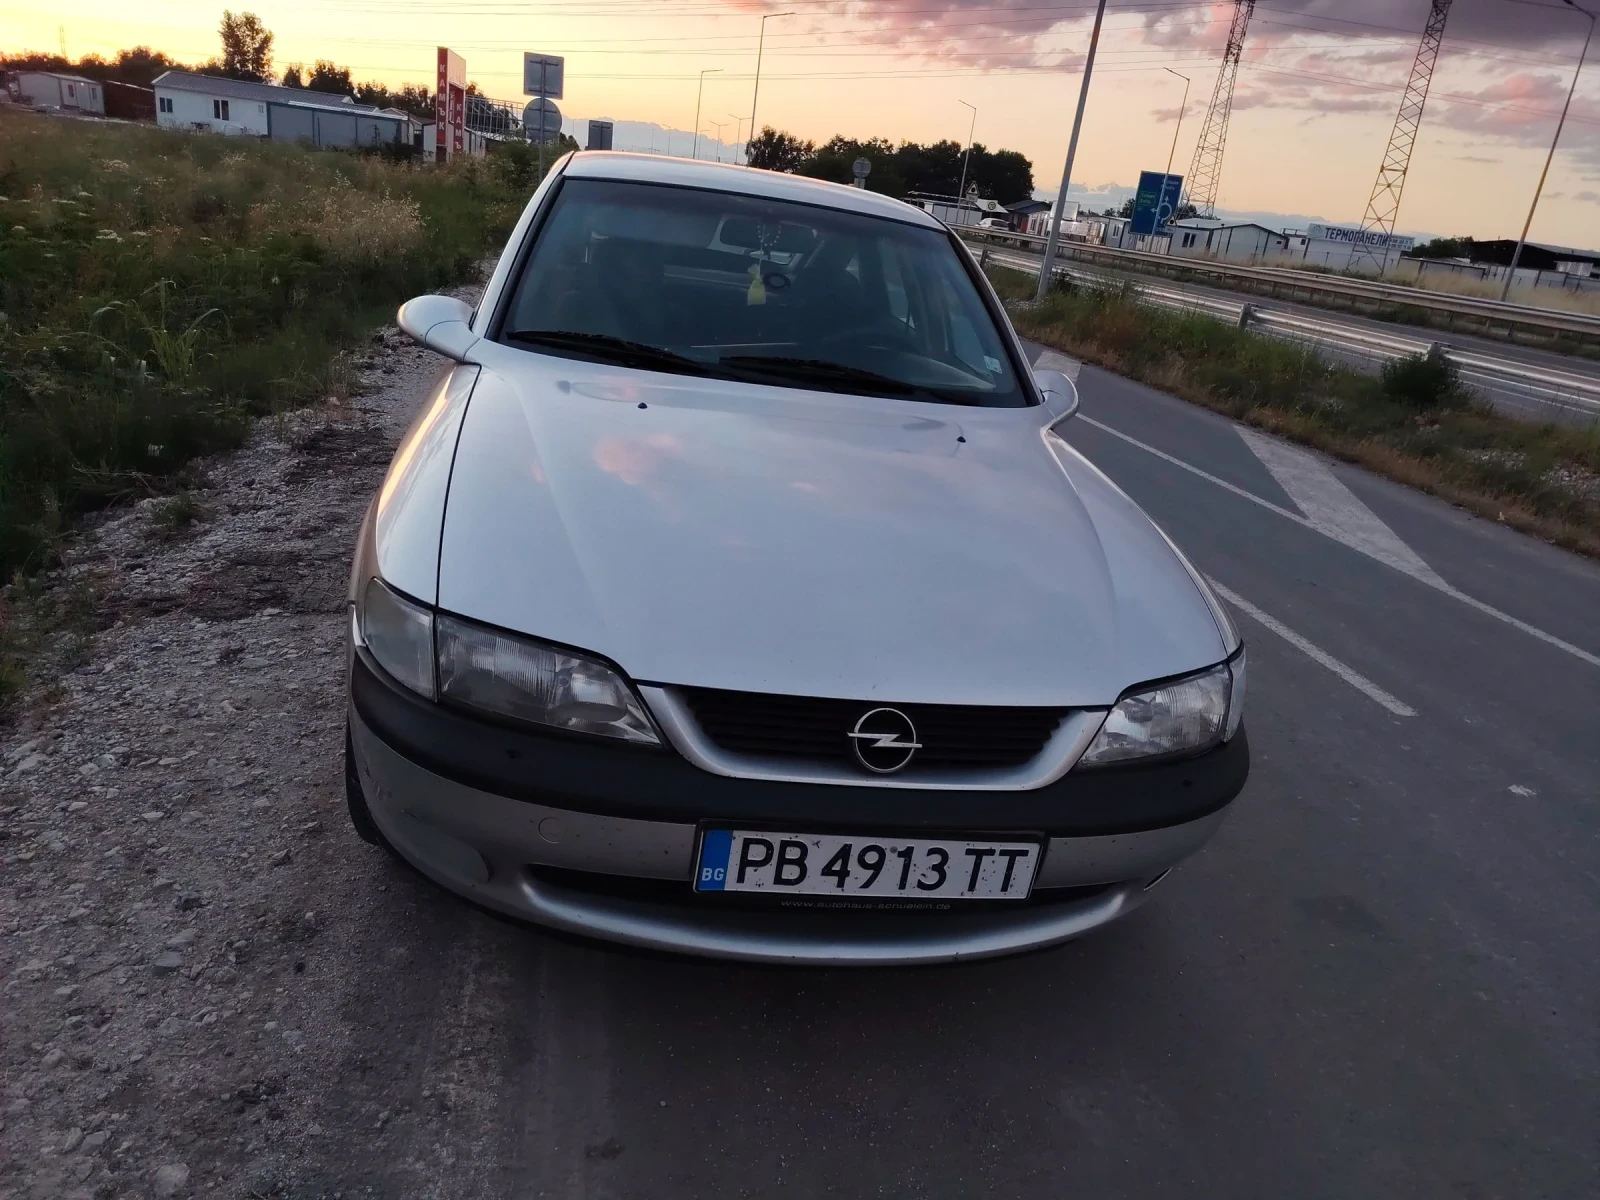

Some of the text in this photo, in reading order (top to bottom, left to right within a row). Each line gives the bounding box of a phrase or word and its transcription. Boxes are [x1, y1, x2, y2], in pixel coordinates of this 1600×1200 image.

[438, 64, 446, 130] КАМЪК
[454, 103, 462, 150] КАМЪ
[1325, 227, 1389, 247] ТЕРМОПАНЕЛИ
[702, 867, 724, 881] BG
[736, 837, 1029, 893] PB 4913 TT
